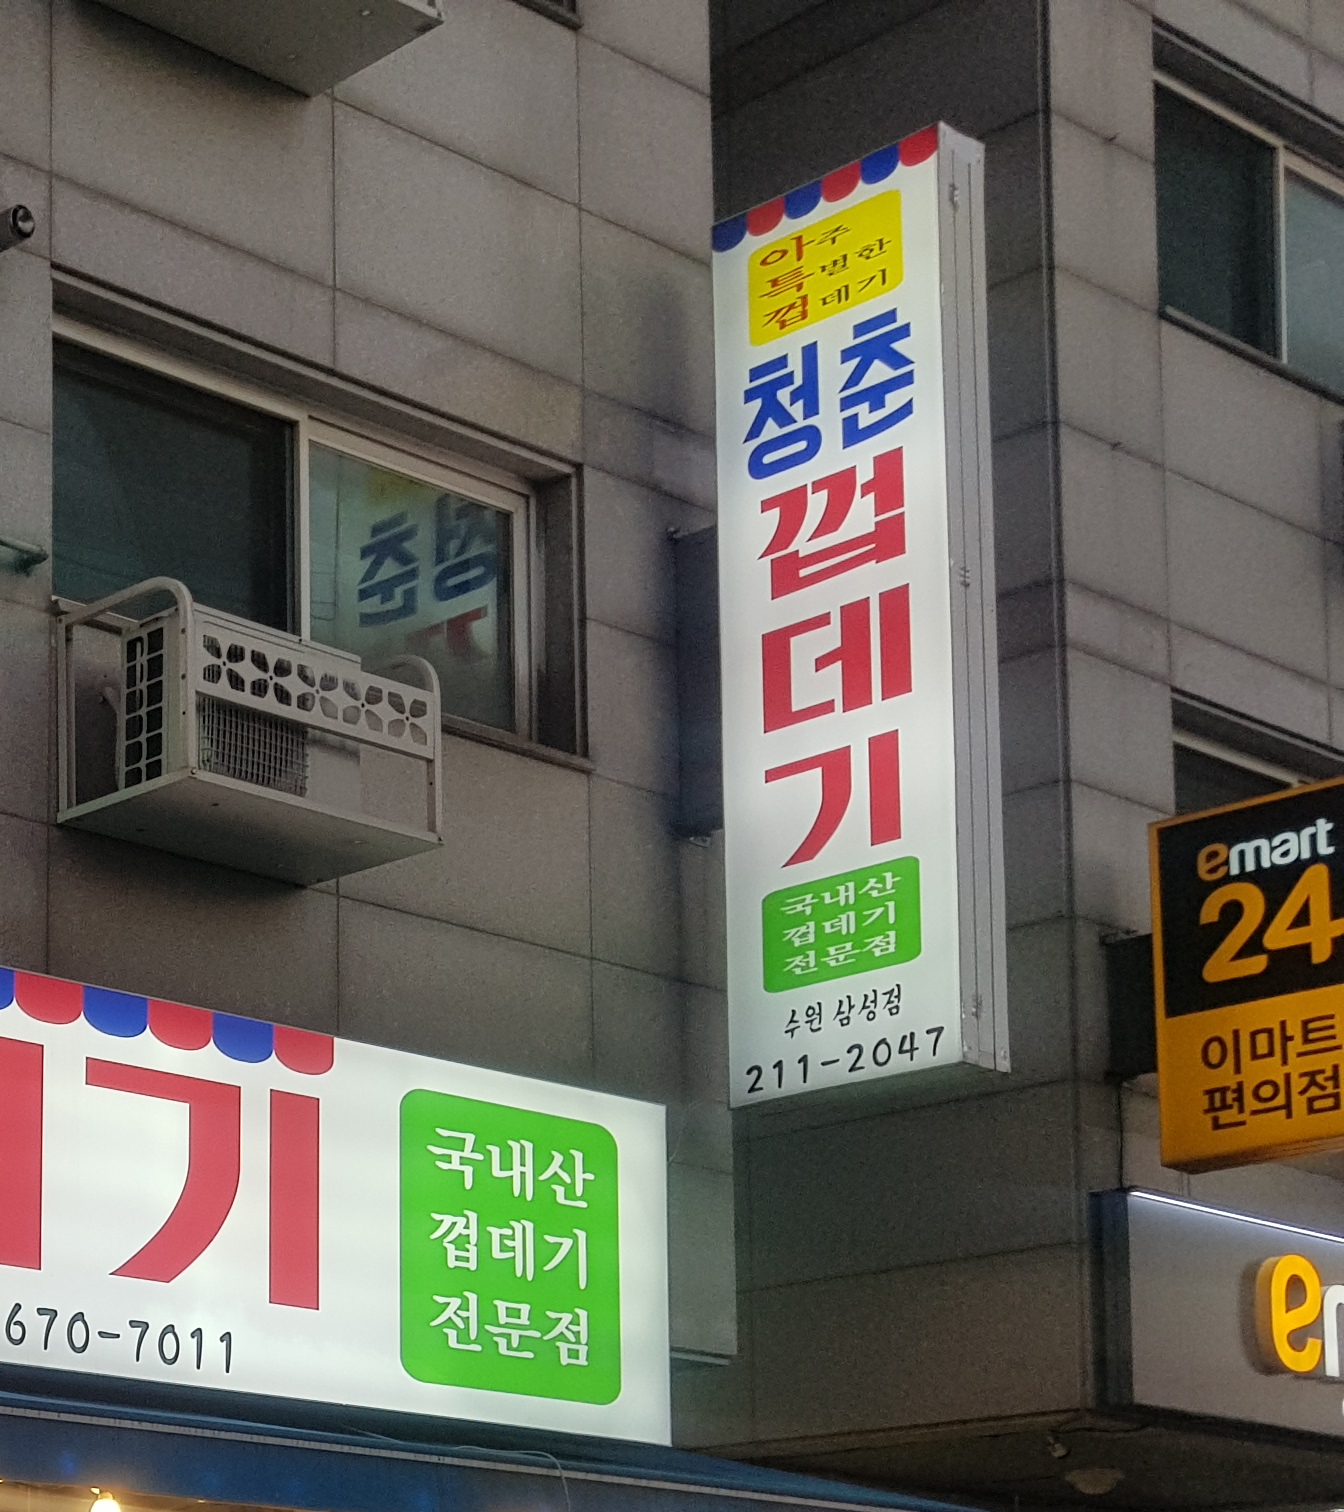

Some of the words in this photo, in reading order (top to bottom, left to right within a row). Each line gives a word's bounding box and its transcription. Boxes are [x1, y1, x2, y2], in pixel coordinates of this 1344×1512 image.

[759, 223, 851, 267] 아주
[759, 238, 892, 299] 특별한
[763, 268, 888, 331] 껍데기
[743, 308, 915, 480] 청춘
[757, 446, 912, 868] 껍데기
[1197, 817, 1336, 882] emart
[780, 872, 901, 915] 국내산
[782, 902, 896, 948] 껍데기
[1198, 862, 1344, 983] 24
[783, 932, 898, 976] 전문점
[784, 1002, 824, 1040] 수원
[832, 984, 903, 1028] 삼성점
[746, 1026, 946, 1094] 211-2047
[1201, 1014, 1344, 1076] 이마트
[1202, 1064, 1344, 1132] 편의점
[427, 1125, 595, 1209] 국내산
[429, 1208, 591, 1291] 껍데기
[427, 1290, 591, 1367] 전문점
